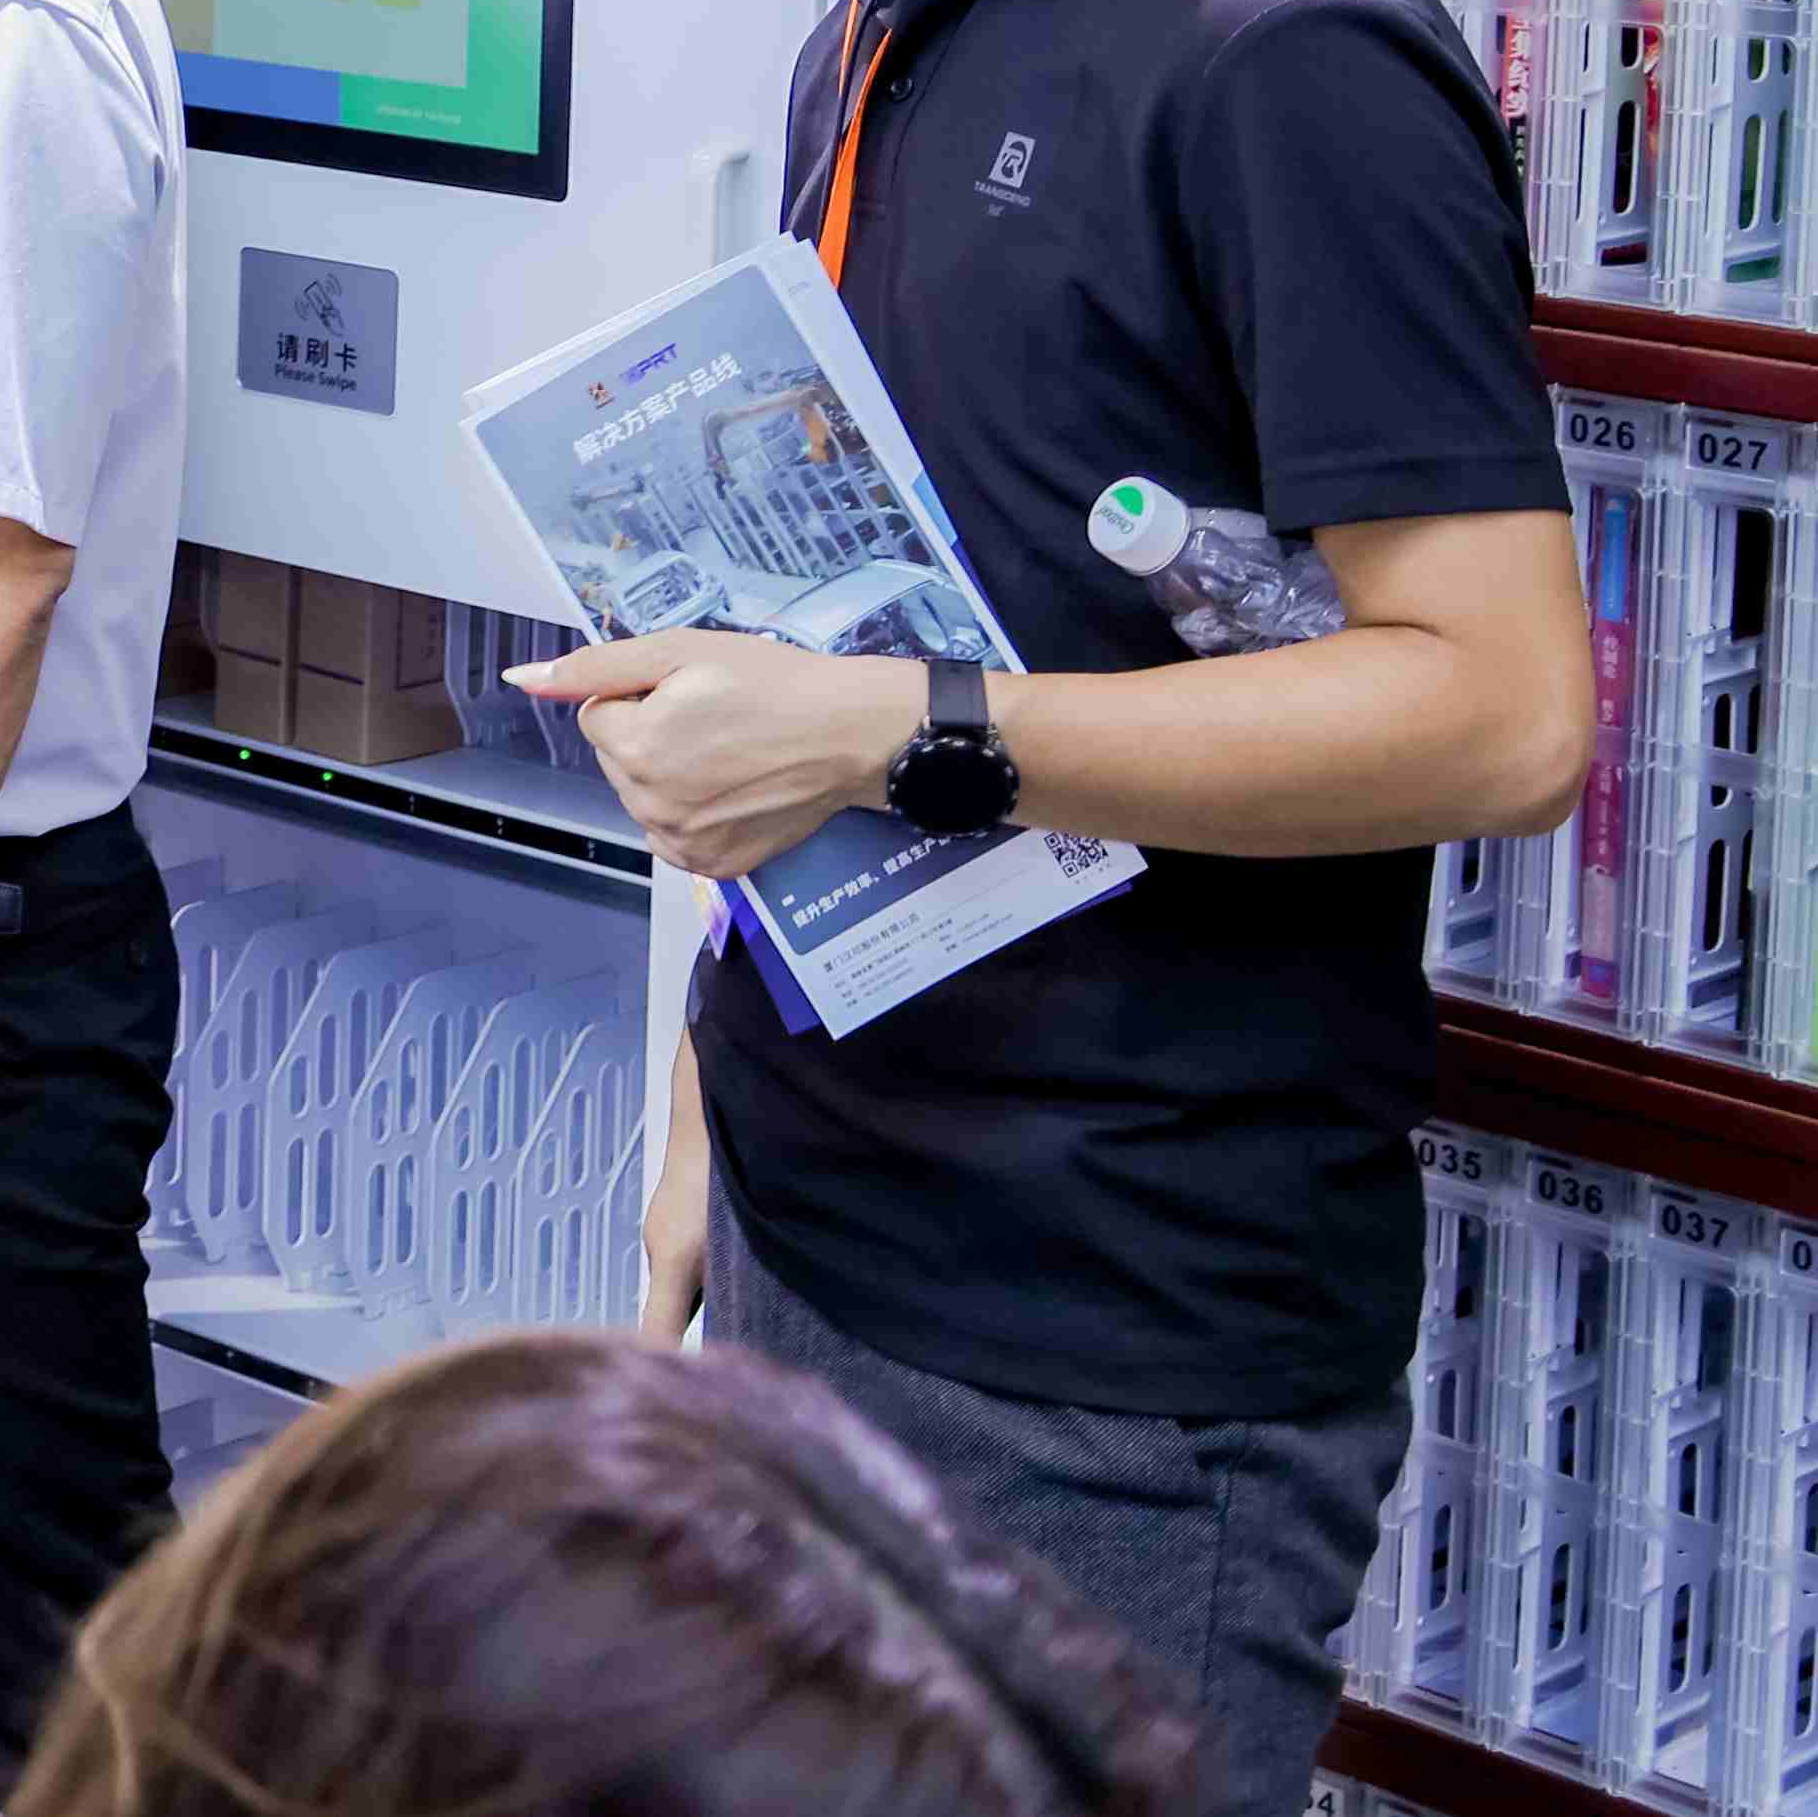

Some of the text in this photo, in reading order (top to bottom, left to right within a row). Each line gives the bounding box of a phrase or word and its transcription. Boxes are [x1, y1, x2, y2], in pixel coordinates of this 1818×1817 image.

[276, 332, 358, 373] 请刷卡
[274, 363, 358, 393] Please Swipe
[1569, 412, 1637, 452] 026
[1697, 432, 1769, 472] 027
[1416, 1137, 1483, 1182] 035
[1537, 1170, 1605, 1216] 036
[1662, 1202, 1730, 1250] 037
